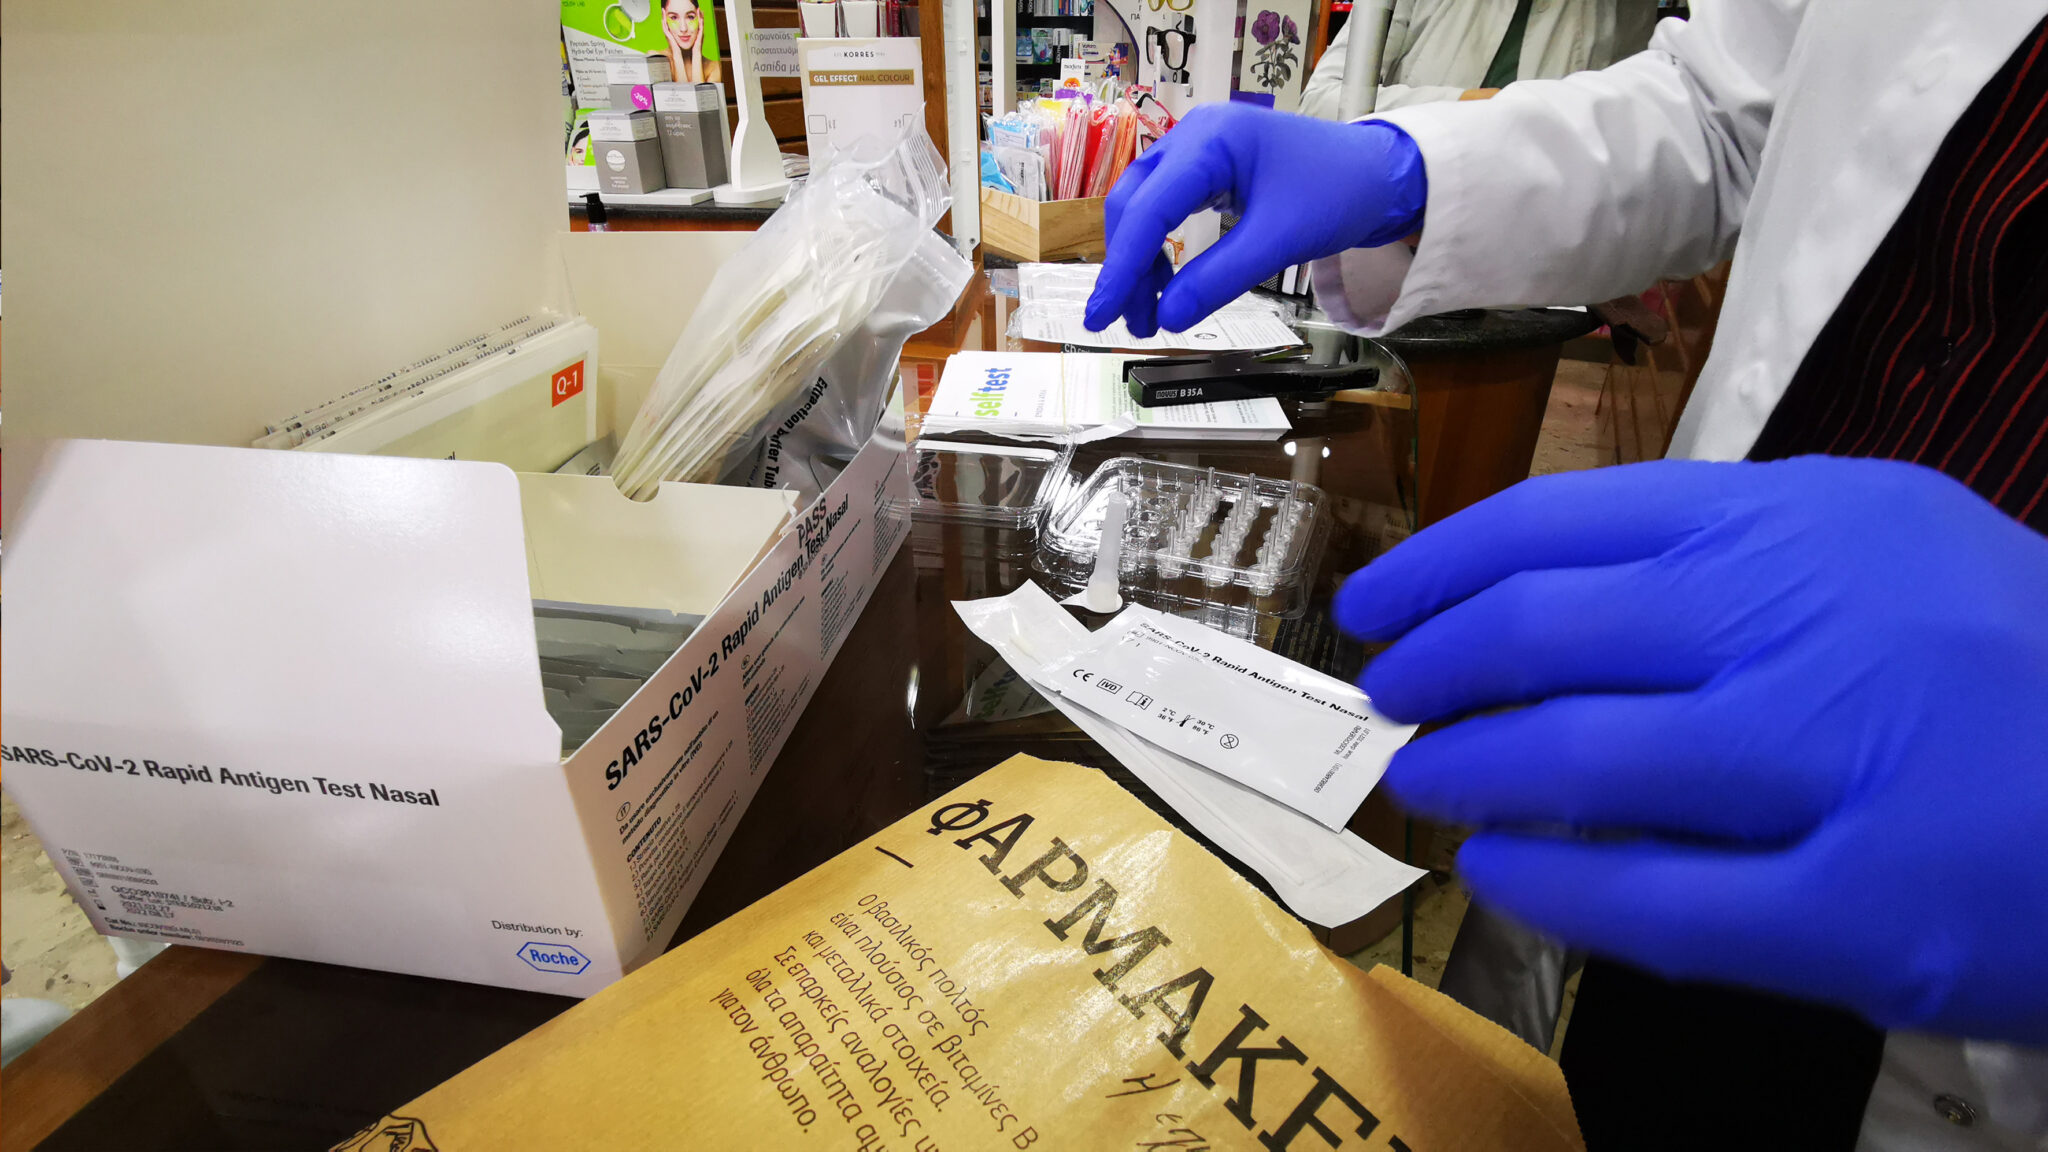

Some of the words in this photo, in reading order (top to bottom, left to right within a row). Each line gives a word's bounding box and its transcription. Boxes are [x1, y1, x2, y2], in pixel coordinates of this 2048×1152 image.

[753, 60, 787, 73] Ασπίδα
[813, 75, 828, 83] GEL
[829, 74, 858, 82] EFFECT
[859, 74, 876, 82] NAIL
[877, 73, 910, 81] COLOUR
[556, 370, 578, 395] Q-1
[783, 376, 828, 430] Extraction
[767, 426, 790, 463] buffer
[796, 497, 827, 549] PASS
[605, 652, 719, 790] SARS-CoV-2
[721, 602, 760, 661] Rapid
[763, 554, 804, 615] Antigen
[805, 527, 824, 558] Test
[825, 493, 849, 536] Nasal
[1100, 680, 1118, 691] IVD
[1139, 622, 1211, 658] SARSCoV-2
[1212, 655, 1248, 675] Rapid
[1248, 671, 1297, 694] Antigen
[1300, 691, 1327, 706] Test
[1329, 703, 1369, 722] Nasal
[1, 744, 141, 776] SARS-CoV-2
[143, 759, 214, 785] Rapid
[219, 767, 310, 795] Antigen
[312, 776, 366, 799] Test
[368, 782, 440, 806] Nasal
[619, 820, 628, 835] Da
[626, 815, 661, 863] CONTENUTO
[491, 920, 562, 936] Distribution
[565, 927, 584, 939] by:
[802, 929, 826, 951] και
[529, 949, 580, 966] Roche
[812, 945, 894, 1024] μεταλλικά
[869, 900, 936, 972] βασιλικός
[928, 968, 990, 1038] πολτός
[929, 797, 1413, 1152] ΦΑΡΜΑΚΕ
[773, 945, 797, 968] Σε
[786, 961, 850, 1035] επαρκείς
[840, 1030, 922, 1138] αναλογίες
[829, 911, 863, 939] είναι
[854, 935, 924, 1012] πλούσιος
[917, 1009, 945, 1038] σε
[932, 1034, 1019, 1133] βιταμίνες
[709, 987, 737, 1012] για
[733, 1003, 759, 1035] τον
[748, 1034, 818, 1134] άνθρωπο.
[745, 966, 771, 993] όλα
[763, 985, 788, 1013] τα
[778, 1010, 863, 1124] απαραίτητα
[856, 1124, 888, 1152] αμ
[881, 1023, 951, 1113] στοιχεία.
